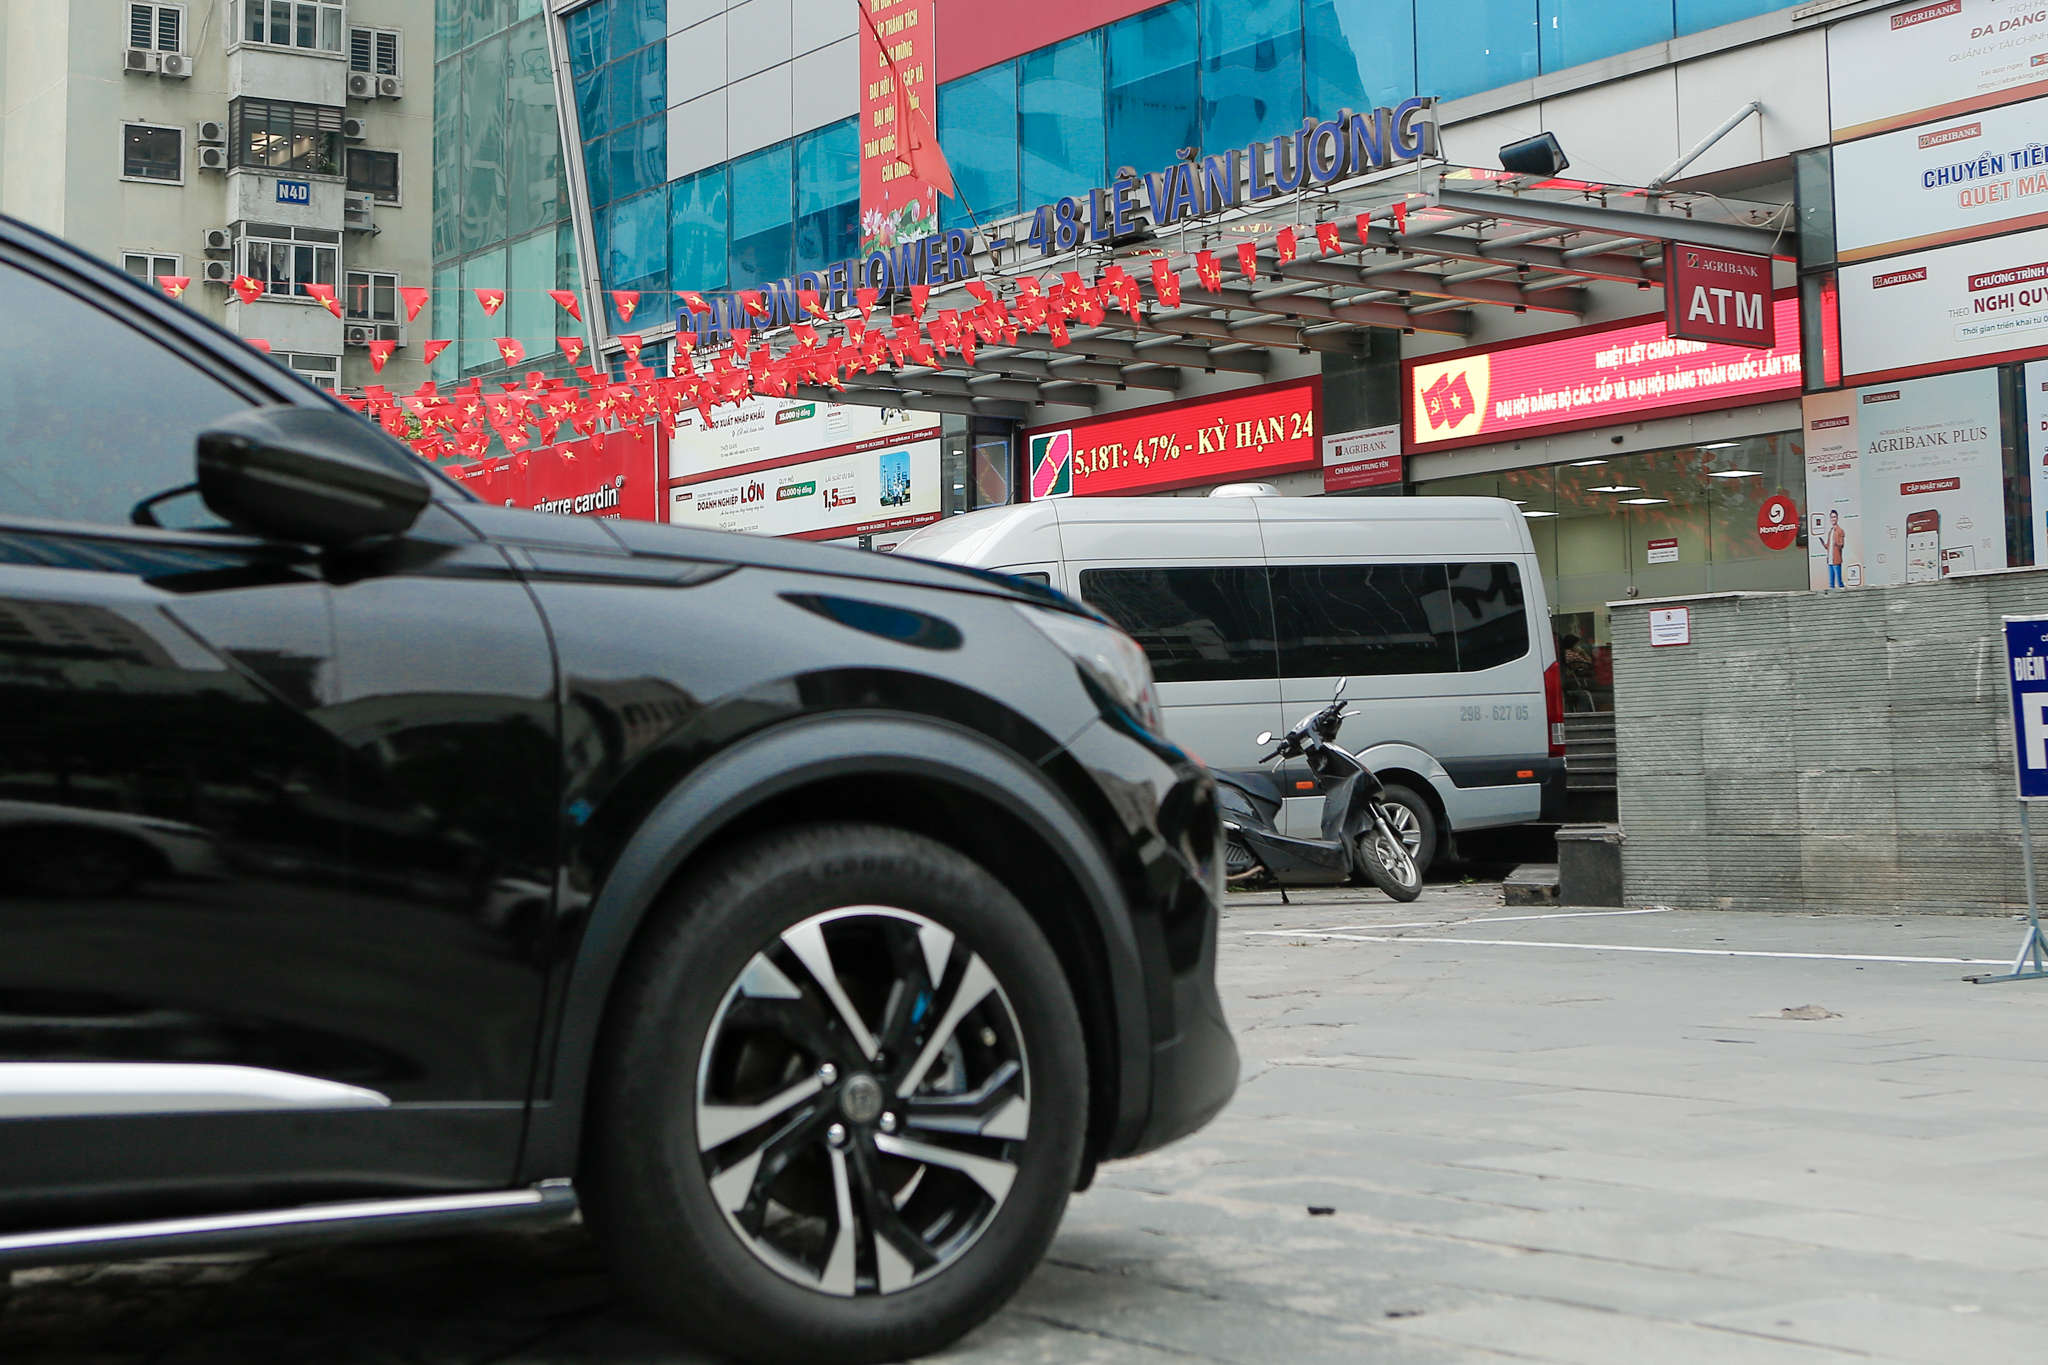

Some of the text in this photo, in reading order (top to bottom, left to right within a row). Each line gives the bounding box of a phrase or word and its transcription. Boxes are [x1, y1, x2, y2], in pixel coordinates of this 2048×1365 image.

[885, 14, 904, 36] THÀNH
[904, 8, 918, 29] TÍCH
[1904, 4, 1958, 25] AGRIBANK
[1970, 10, 2046, 40] ĐA DẠNG
[895, 40, 913, 62] MỪNG
[1992, 66, 2005, 75] app
[2006, 62, 2024, 72] ngay
[869, 81, 880, 102] ĐẠI
[880, 75, 890, 98] HỘI
[916, 62, 924, 83] VÀ
[874, 102, 895, 129] ĐẠI HỘI
[1930, 127, 1978, 145] AGRIBANK
[864, 138, 880, 160] TOÀN
[882, 160, 894, 182] CỦA
[1923, 152, 2003, 188] CHUYỂN
[279, 184, 308, 200] N4D
[1960, 171, 2048, 208] QUÉT MÃ
[676, 271, 826, 346] DIAMOND
[829, 228, 972, 311] FLOWER
[1028, 196, 1084, 256] 48
[1090, 167, 1140, 242] LÊ
[1144, 147, 1240, 225] VĂN
[1248, 96, 1436, 200] LƯƠNG
[1702, 260, 1758, 277] AGRIBANK
[1882, 270, 1924, 286] AGRIBANK
[1974, 272, 2016, 288] CHƯƠNG
[2016, 266, 2045, 282] TRÌNH
[1688, 285, 1764, 330] ATM
[1948, 307, 1970, 318] THEO
[1974, 292, 2014, 314] NGHỊ
[1962, 326, 1978, 336] Thời
[1979, 323, 1996, 335] gian
[2016, 316, 2032, 327] khai
[2033, 314, 2043, 324] từ
[1596, 344, 1624, 370] NHIỆT
[1625, 340, 1646, 367] LIỆT
[1647, 336, 1675, 360] CHÀO
[1496, 400, 1512, 421] ĐẠI
[1513, 393, 1529, 418] HỘI
[1530, 388, 1557, 413] ĐẢNG
[1558, 386, 1572, 411] BỘ
[1572, 383, 1592, 406] CÁC
[1593, 376, 1613, 402] CẤP
[1614, 376, 1628, 399] VÀ
[1628, 378, 1646, 400] ĐẠI
[1648, 371, 1665, 397] HỘI
[1666, 365, 1696, 391] ĐẢNG
[1697, 362, 1726, 386] TOÀN
[1728, 353, 1758, 382] QUỐC
[1759, 350, 1780, 377] LẦN
[1074, 443, 1129, 478] 5,18T:
[1133, 433, 1180, 469] 4,7%
[1197, 418, 1230, 455] KỲ
[1235, 415, 1286, 453] HẠN
[1290, 410, 1313, 440] 24
[1343, 441, 1387, 455] AGRIBANK
[1868, 427, 1988, 454] AGRIBANK PLUS
[1344, 464, 1362, 473] NHÁNH
[1362, 462, 1379, 471] TRUNG
[697, 500, 718, 511] DOANH
[718, 494, 738, 507] NGHIỆP
[741, 480, 764, 503] LỚN
[1920, 482, 1936, 491] NHẬT
[533, 484, 617, 515] pierre cardin
[823, 488, 838, 512] 1,5
[1760, 524, 1796, 534] MoneyGram
[2014, 647, 2046, 681] ĐIỂM
[1460, 706, 1481, 721] 29B
[1492, 706, 1512, 721] 627
[1515, 706, 1529, 720] 05
